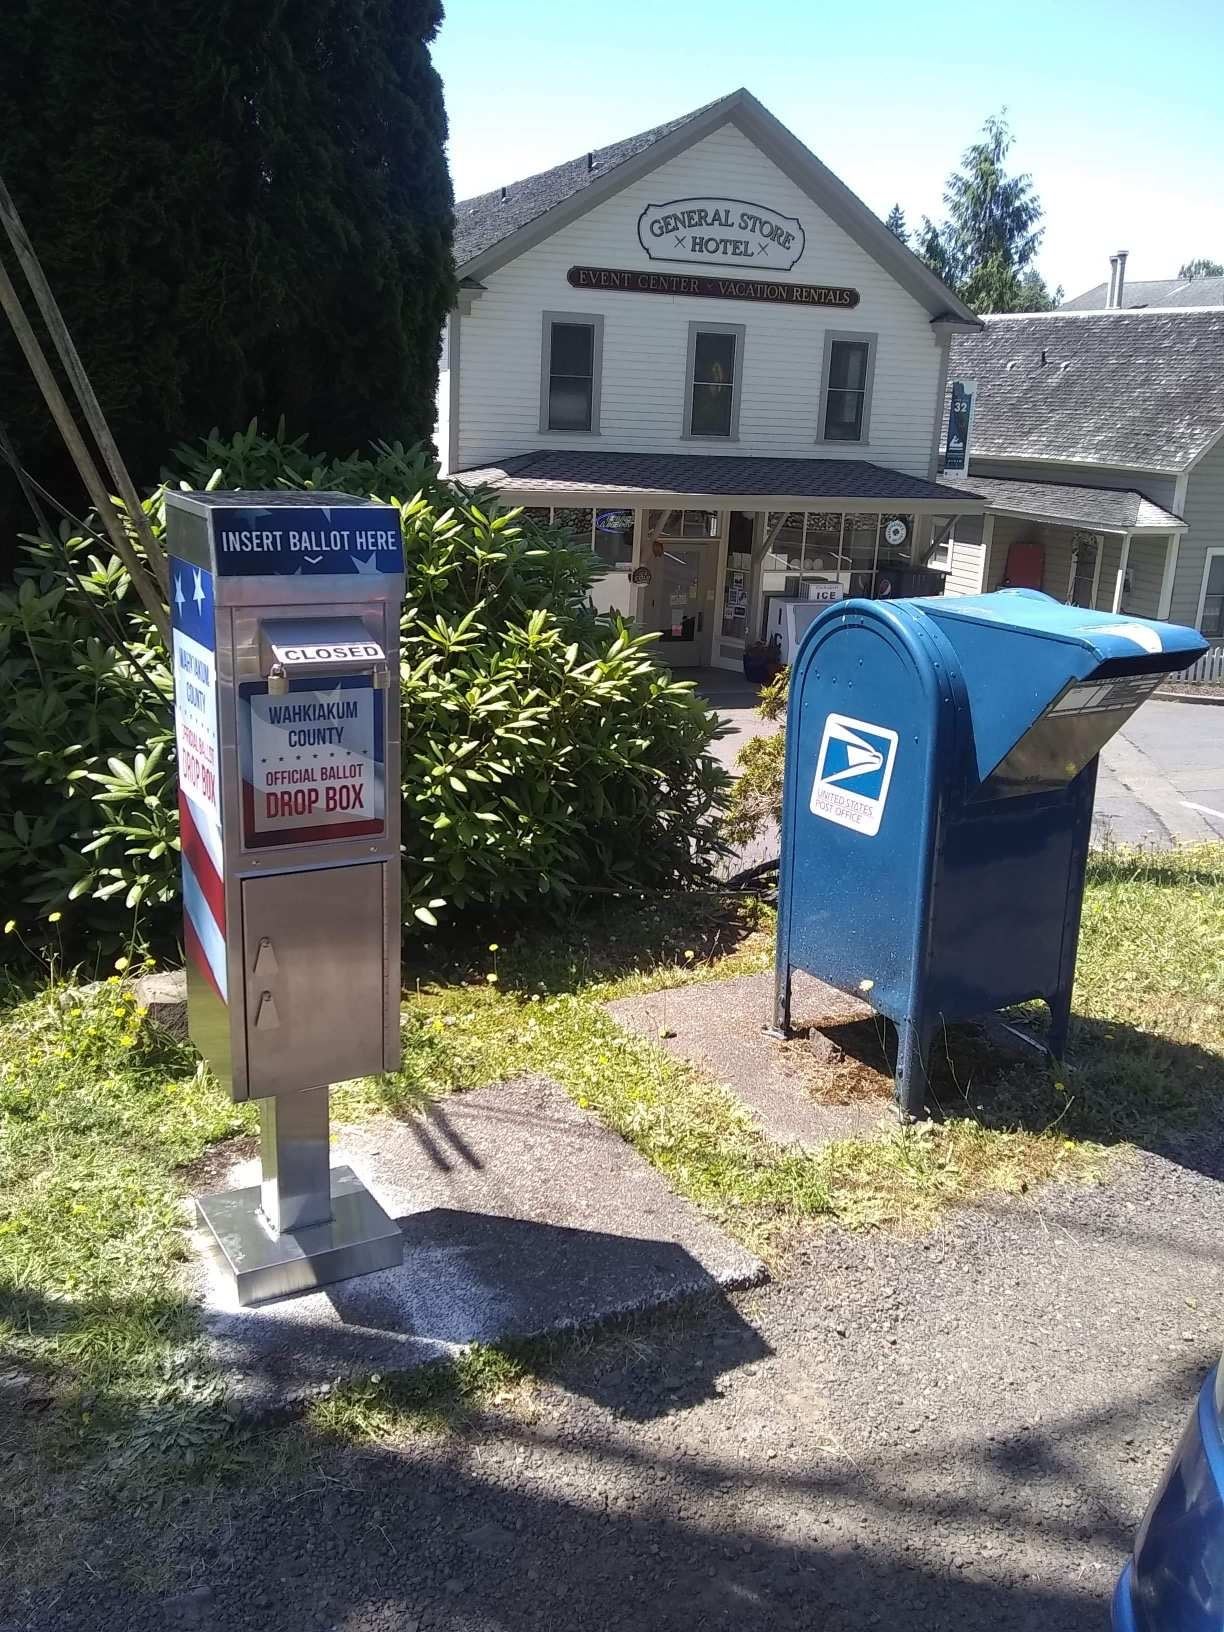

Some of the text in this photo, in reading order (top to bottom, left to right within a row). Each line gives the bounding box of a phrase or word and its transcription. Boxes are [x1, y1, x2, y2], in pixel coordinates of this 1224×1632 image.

[650, 208, 795, 252] GENERAL STORE
[691, 236, 755, 258] HOTEL
[579, 270, 851, 305] EVENT CENTER VACATION RENTALS
[221, 529, 397, 552] INSERT BALLOT HERE
[816, 591, 837, 600] ICE
[284, 645, 379, 662] CLOSED
[269, 701, 358, 725] WAHKIAKUM
[288, 726, 344, 748] COUNTY
[266, 763, 364, 786] OFFICIAL BALLOT
[266, 783, 364, 818] DROP BOX
[817, 787, 873, 817] UNITED STATES
[815, 800, 862, 825] POST OFFICE
